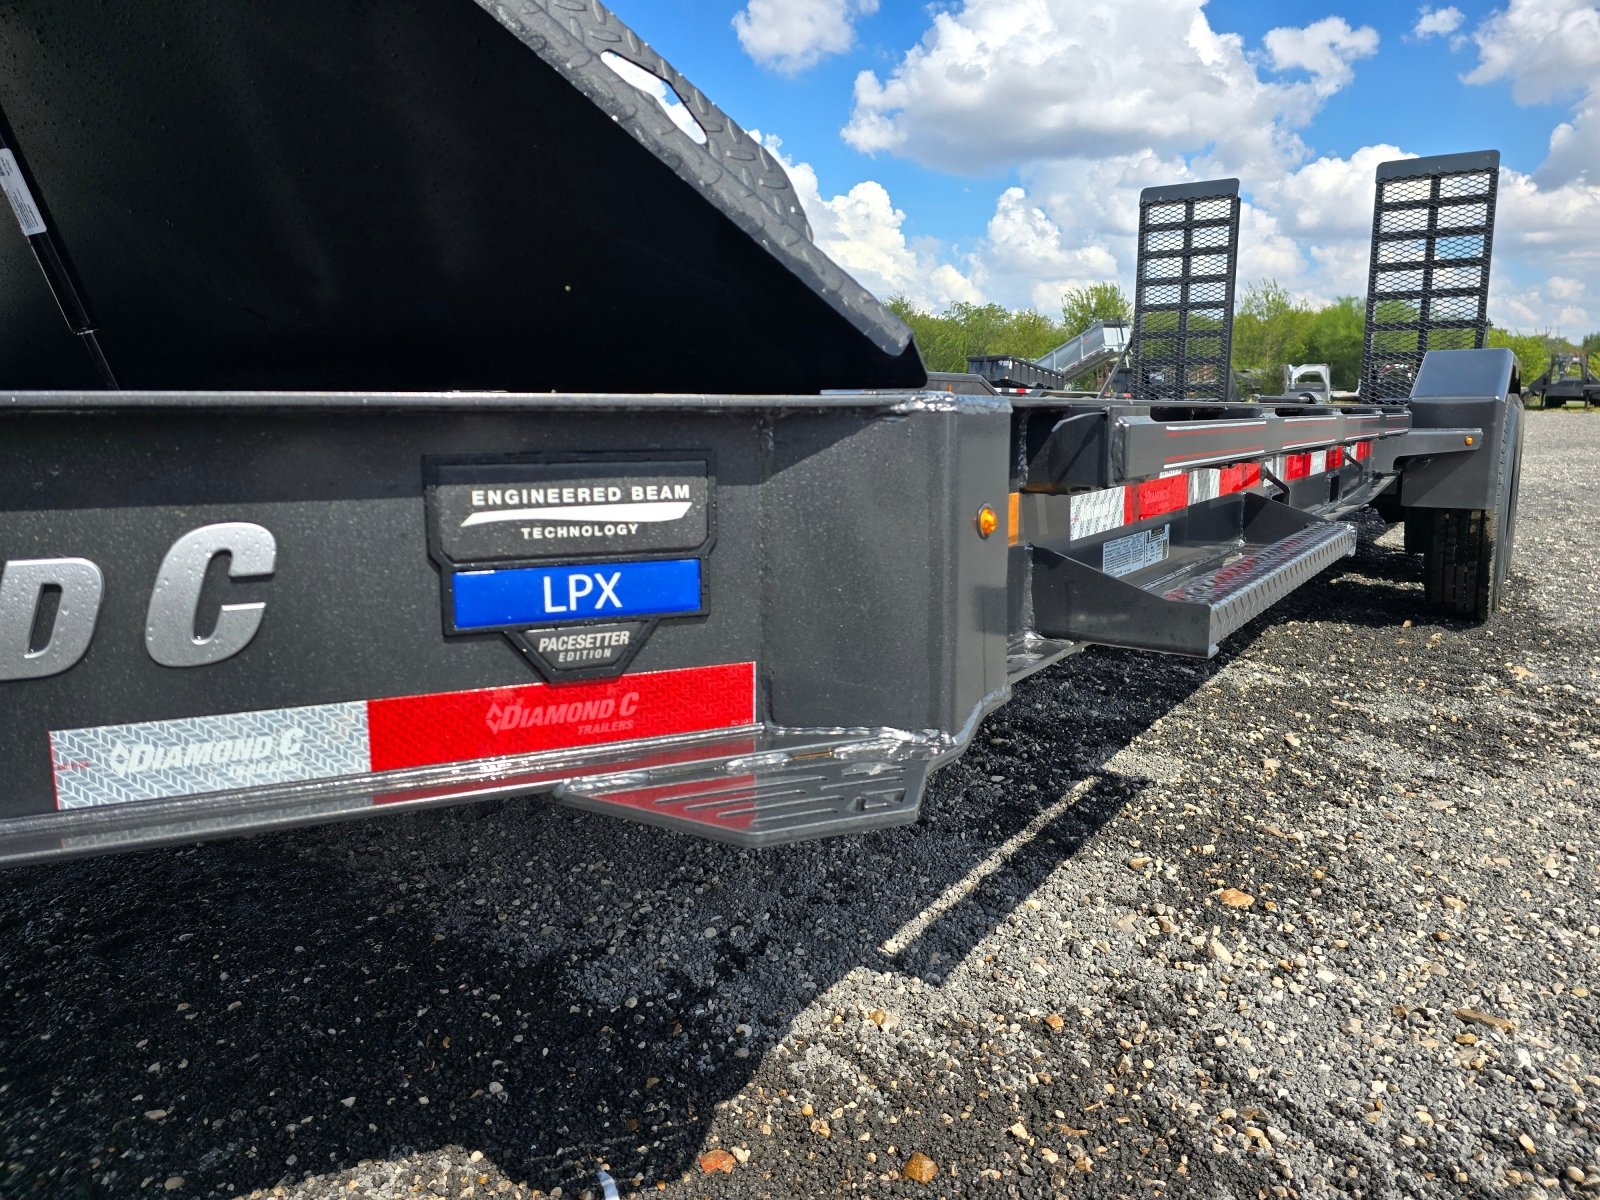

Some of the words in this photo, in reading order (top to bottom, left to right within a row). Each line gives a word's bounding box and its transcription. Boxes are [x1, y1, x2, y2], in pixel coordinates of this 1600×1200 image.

[472, 486, 621, 505] ENGINEERED
[631, 484, 690, 500] BEAM
[521, 523, 639, 539] TECHNOLOGY
[145, 522, 277, 668] C
[543, 572, 623, 613] LPX
[538, 630, 630, 652] PACESETTER
[558, 648, 612, 662] EDITION
[501, 698, 615, 730] DIAMOND
[619, 692, 640, 717] C
[577, 719, 634, 736] TRAILERS
[129, 735, 273, 772] DIAMOND
[279, 728, 304, 755] C
